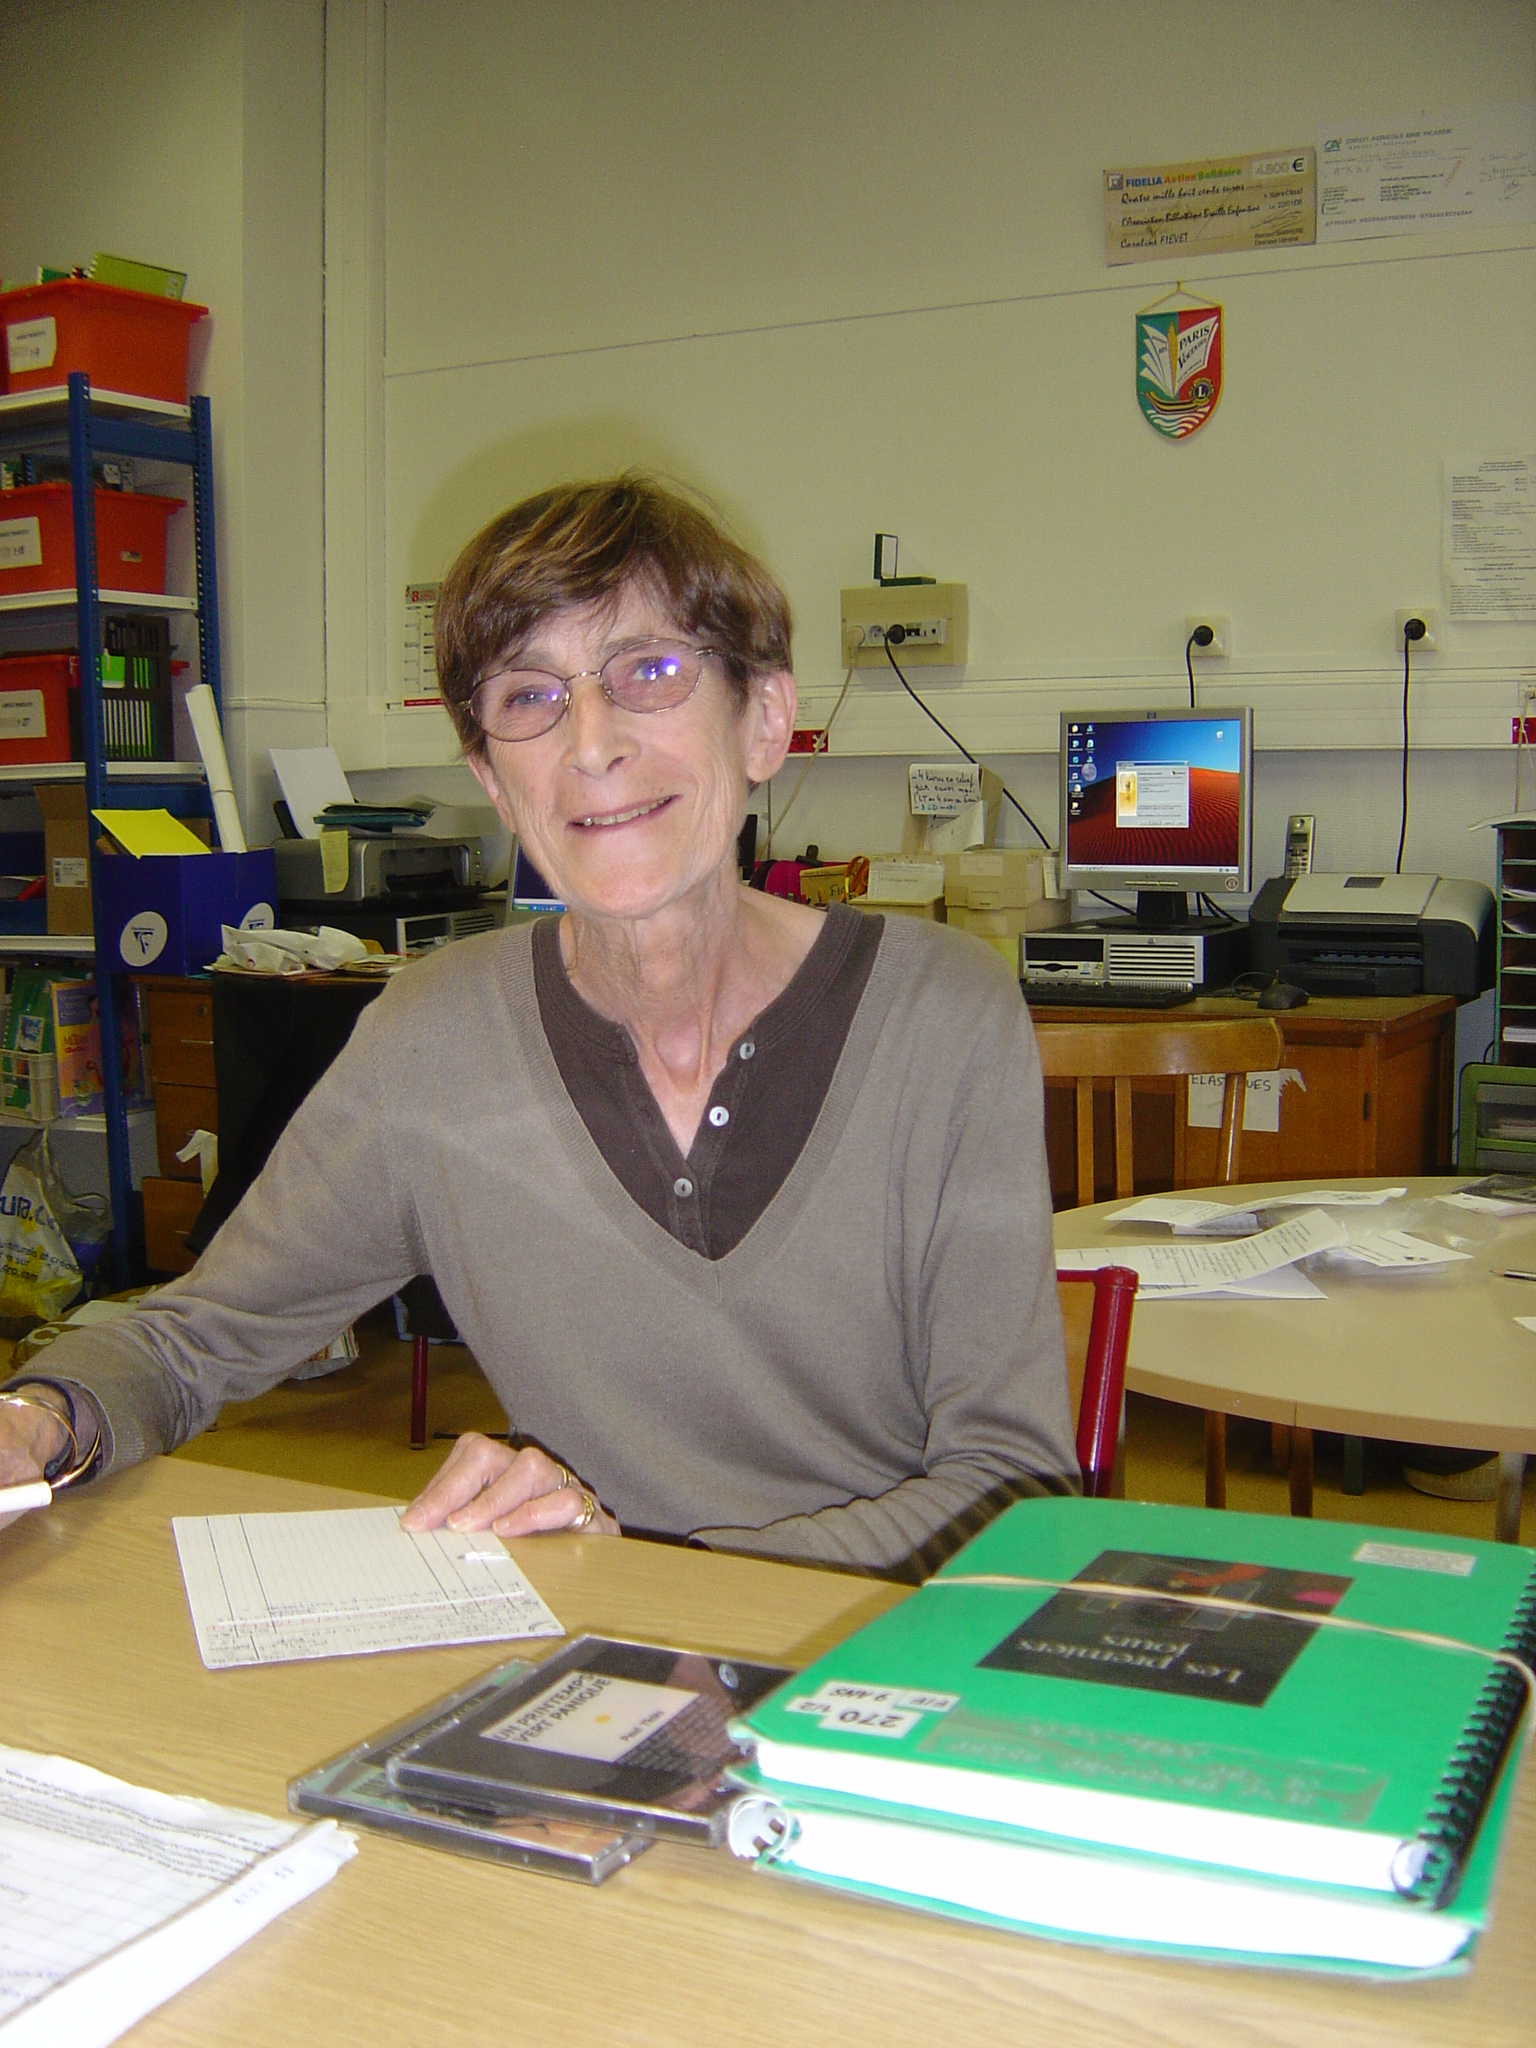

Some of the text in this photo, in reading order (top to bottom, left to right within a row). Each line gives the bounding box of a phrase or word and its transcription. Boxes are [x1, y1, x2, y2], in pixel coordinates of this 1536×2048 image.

[1126, 176, 1163, 189] FIDELIA
[1121, 192, 1151, 204] Quatre
[1153, 188, 1175, 201] mille
[1120, 231, 1189, 249] Caroline FIEVET
[1179, 325, 1210, 351] PARIS
[914, 783, 930, 795] par
[1103, 1635, 1192, 1657] jours
[1019, 1639, 1243, 1684] Les premiers
[829, 1687, 874, 1699] ANS
[874, 1693, 891, 1702] 9
[492, 1722, 518, 1742] UN
[517, 1674, 596, 1727] PRINTEMPS
[513, 1720, 556, 1744] VERT
[553, 1676, 612, 1722] PANIQUE
[839, 1710, 904, 1728] 270
